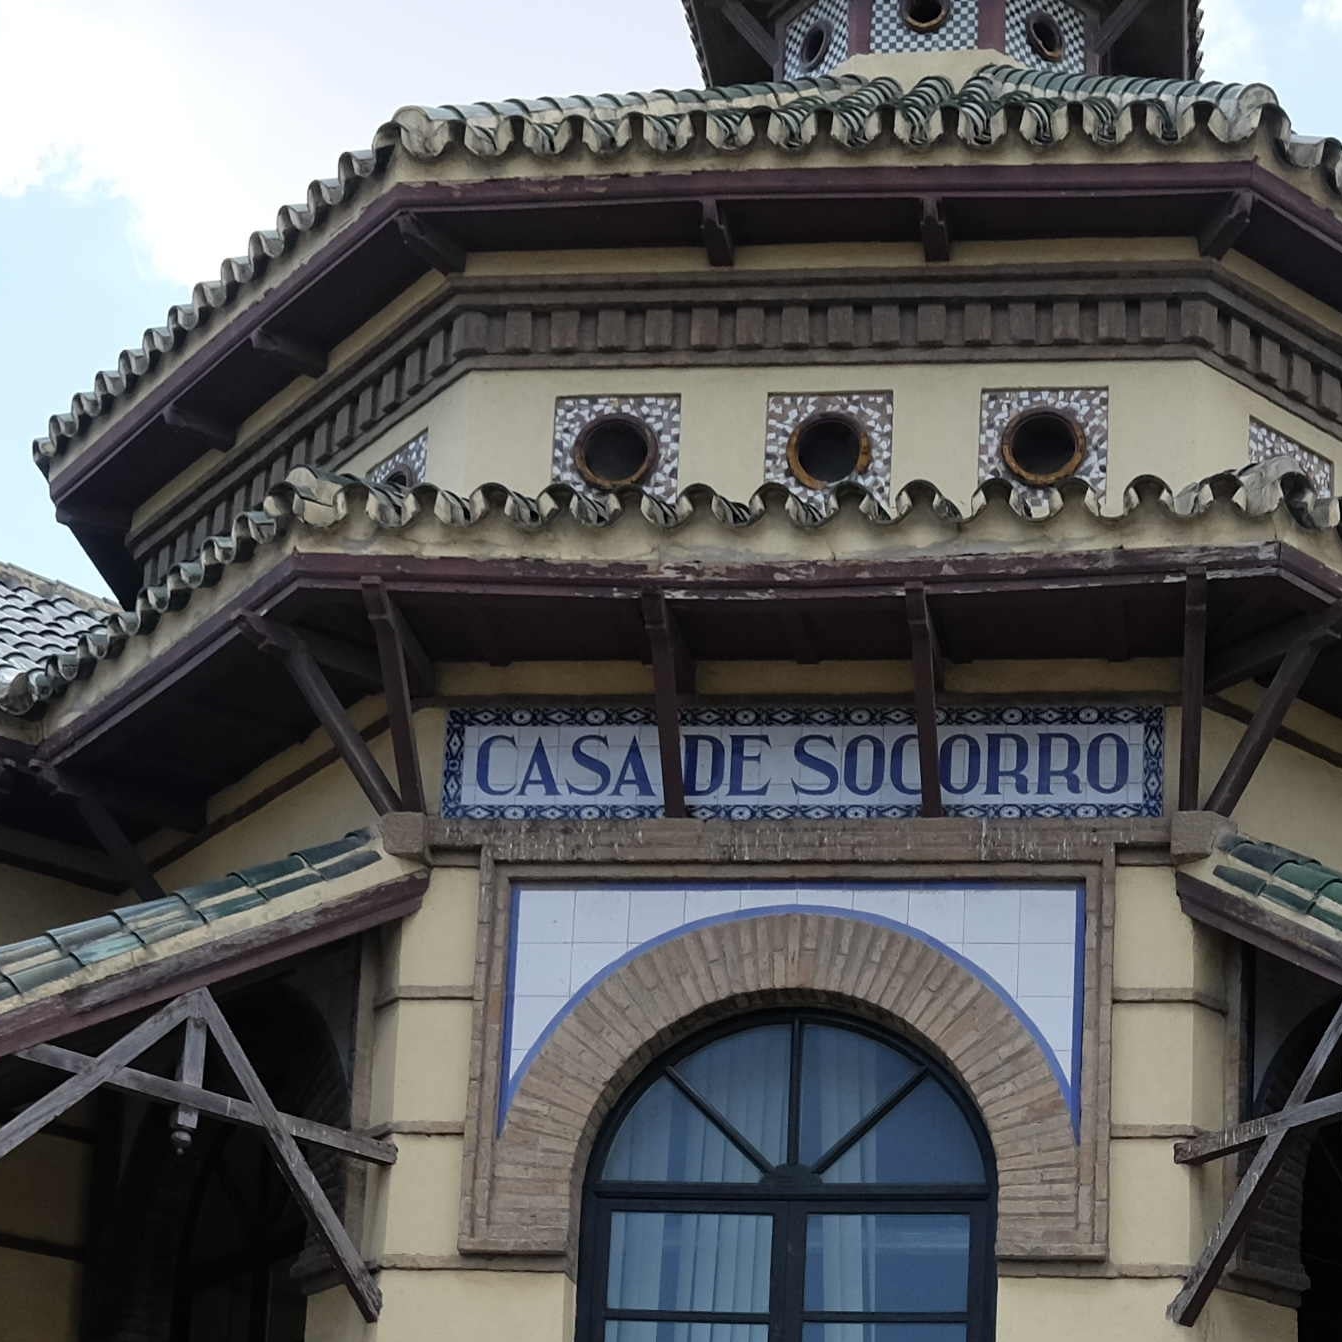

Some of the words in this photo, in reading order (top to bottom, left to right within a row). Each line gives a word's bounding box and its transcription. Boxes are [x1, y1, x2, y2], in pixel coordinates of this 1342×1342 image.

[476, 732, 657, 797] CASA
[683, 733, 771, 797] DE
[791, 731, 1131, 797] SOCORRO
